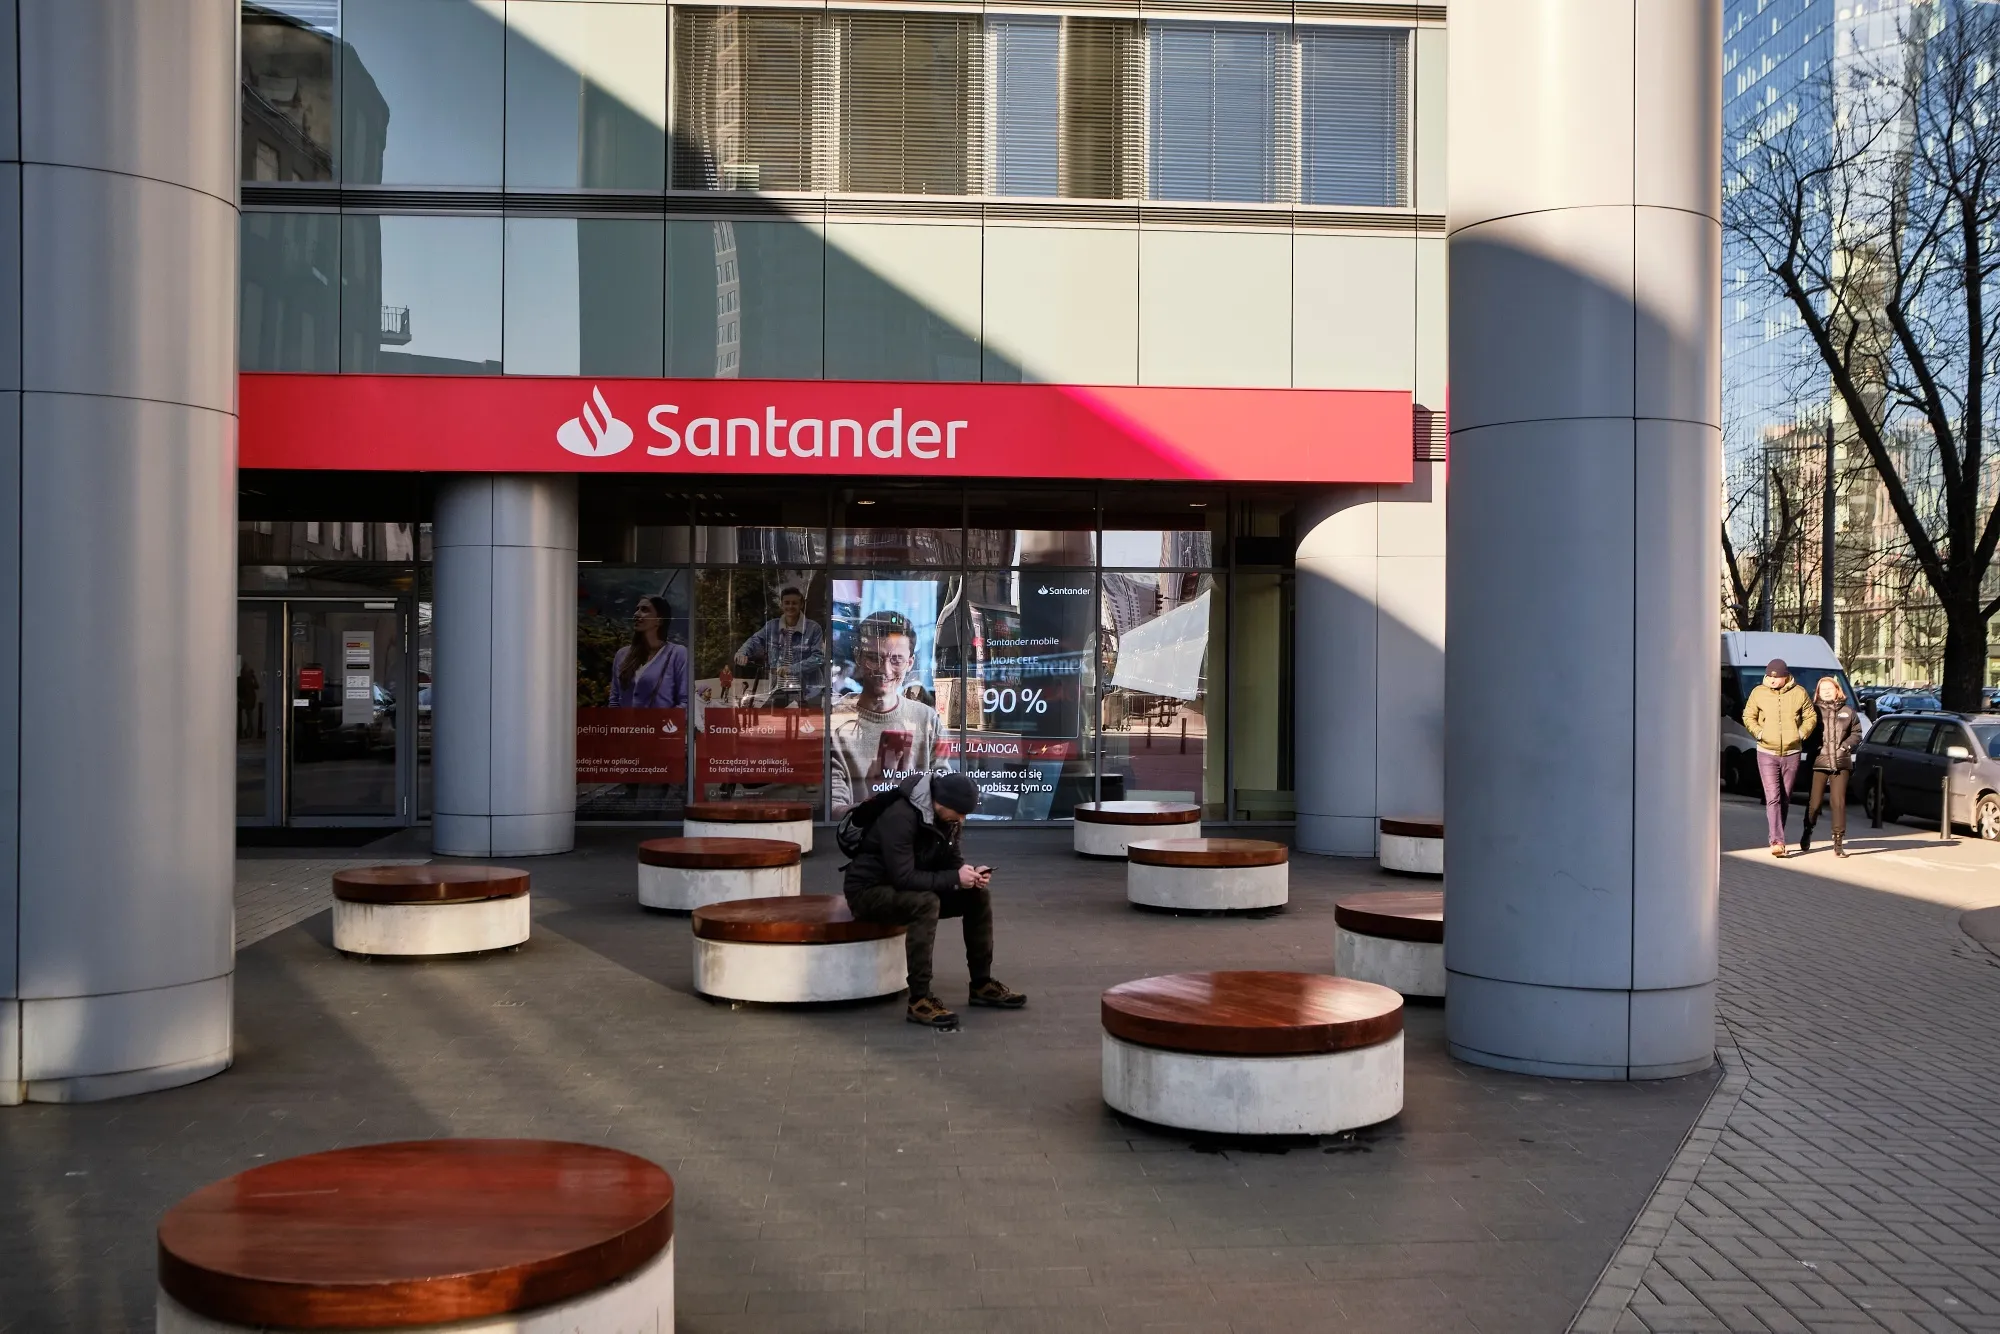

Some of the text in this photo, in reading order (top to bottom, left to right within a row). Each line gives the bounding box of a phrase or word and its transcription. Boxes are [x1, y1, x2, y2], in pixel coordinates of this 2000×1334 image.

[646, 404, 968, 459] Santander
[1049, 587, 1091, 595] Santander
[986, 637, 1059, 647] Santander mobile
[990, 656, 1039, 665] MOJE CELE
[983, 687, 1047, 713] 90 %
[577, 724, 655, 736] pełniaj marzenia
[709, 725, 776, 736] Samo się robi
[576, 757, 591, 766] odaj
[611, 757, 640, 766] aplikacji
[709, 758, 748, 767] Oszczędzaj
[758, 758, 790, 767] aplikacji,
[609, 766, 629, 775] niego
[630, 766, 668, 775] oszczędzać
[718, 766, 754, 774] łatwiejsze
[768, 766, 794, 775] myślisz
[883, 769, 894, 778] W
[1019, 769, 1026, 778] ci
[1028, 769, 1042, 780] się
[983, 782, 1012, 792] robisz
[1021, 783, 1039, 794] tym
[1041, 784, 1053, 792] co
